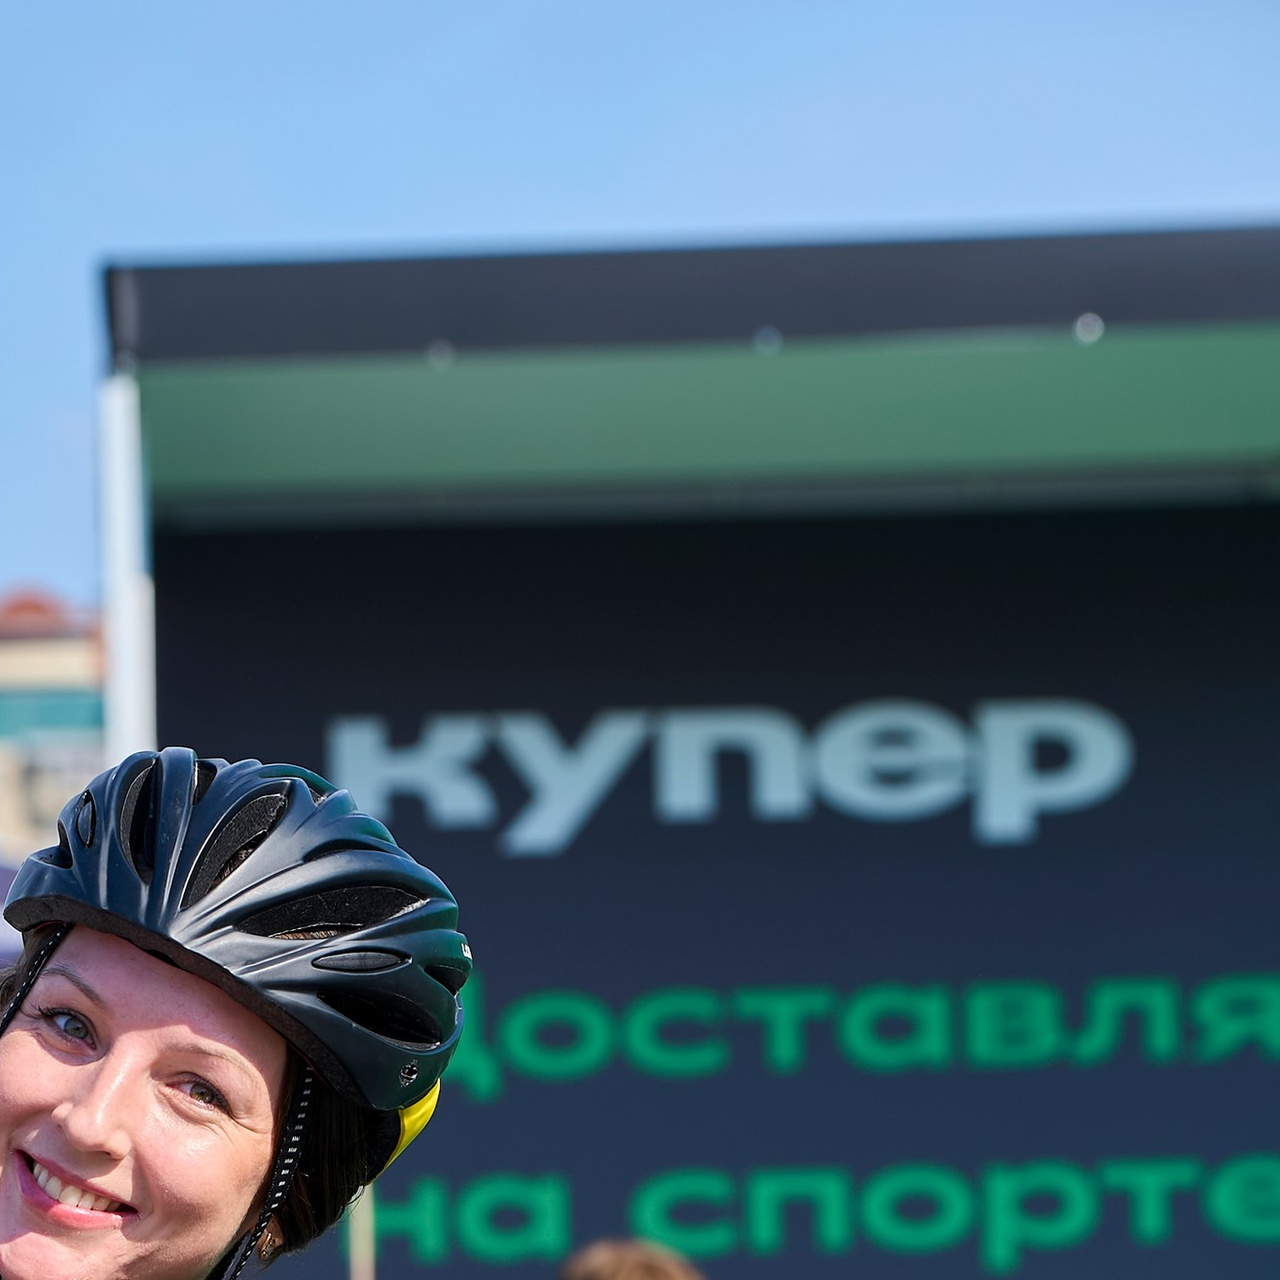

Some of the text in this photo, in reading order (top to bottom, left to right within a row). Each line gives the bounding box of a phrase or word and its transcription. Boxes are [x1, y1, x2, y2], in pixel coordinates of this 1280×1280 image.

[324, 698, 1133, 858] купер
[344, 1154, 1280, 1276] на спорте
